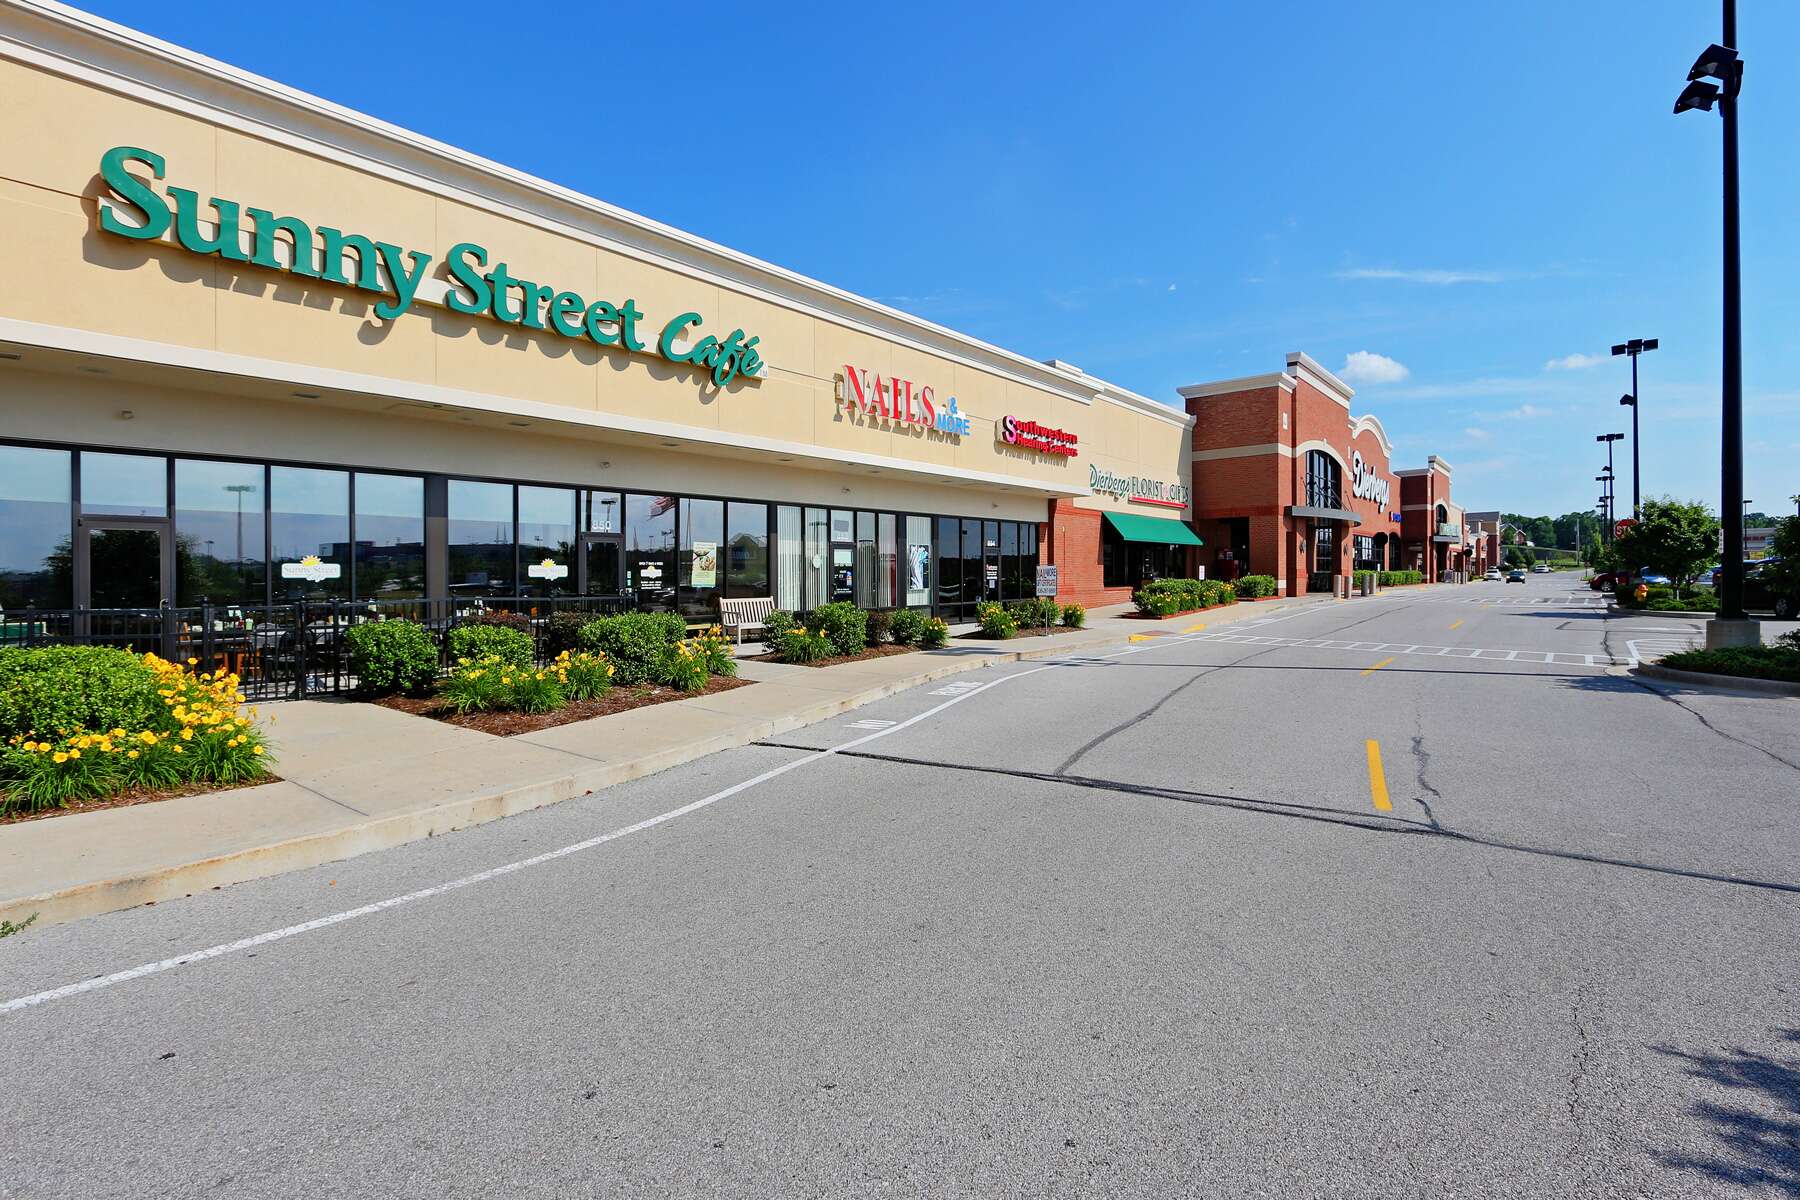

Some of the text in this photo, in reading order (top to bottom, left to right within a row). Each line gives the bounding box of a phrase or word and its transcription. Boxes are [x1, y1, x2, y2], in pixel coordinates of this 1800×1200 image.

[100, 146, 432, 320] Sunny
[447, 243, 646, 352] Street
[658, 311, 765, 387] Café
[843, 364, 936, 429] NAILS
[936, 412, 971, 437] MORE
[1002, 415, 1078, 445] Southwestern
[1016, 432, 1049, 453] Hearing
[1089, 463, 1130, 498] Dierbergs
[1131, 476, 1164, 500] FLORIST
[1169, 484, 1189, 503] GIFTS
[591, 520, 611, 530] 850
